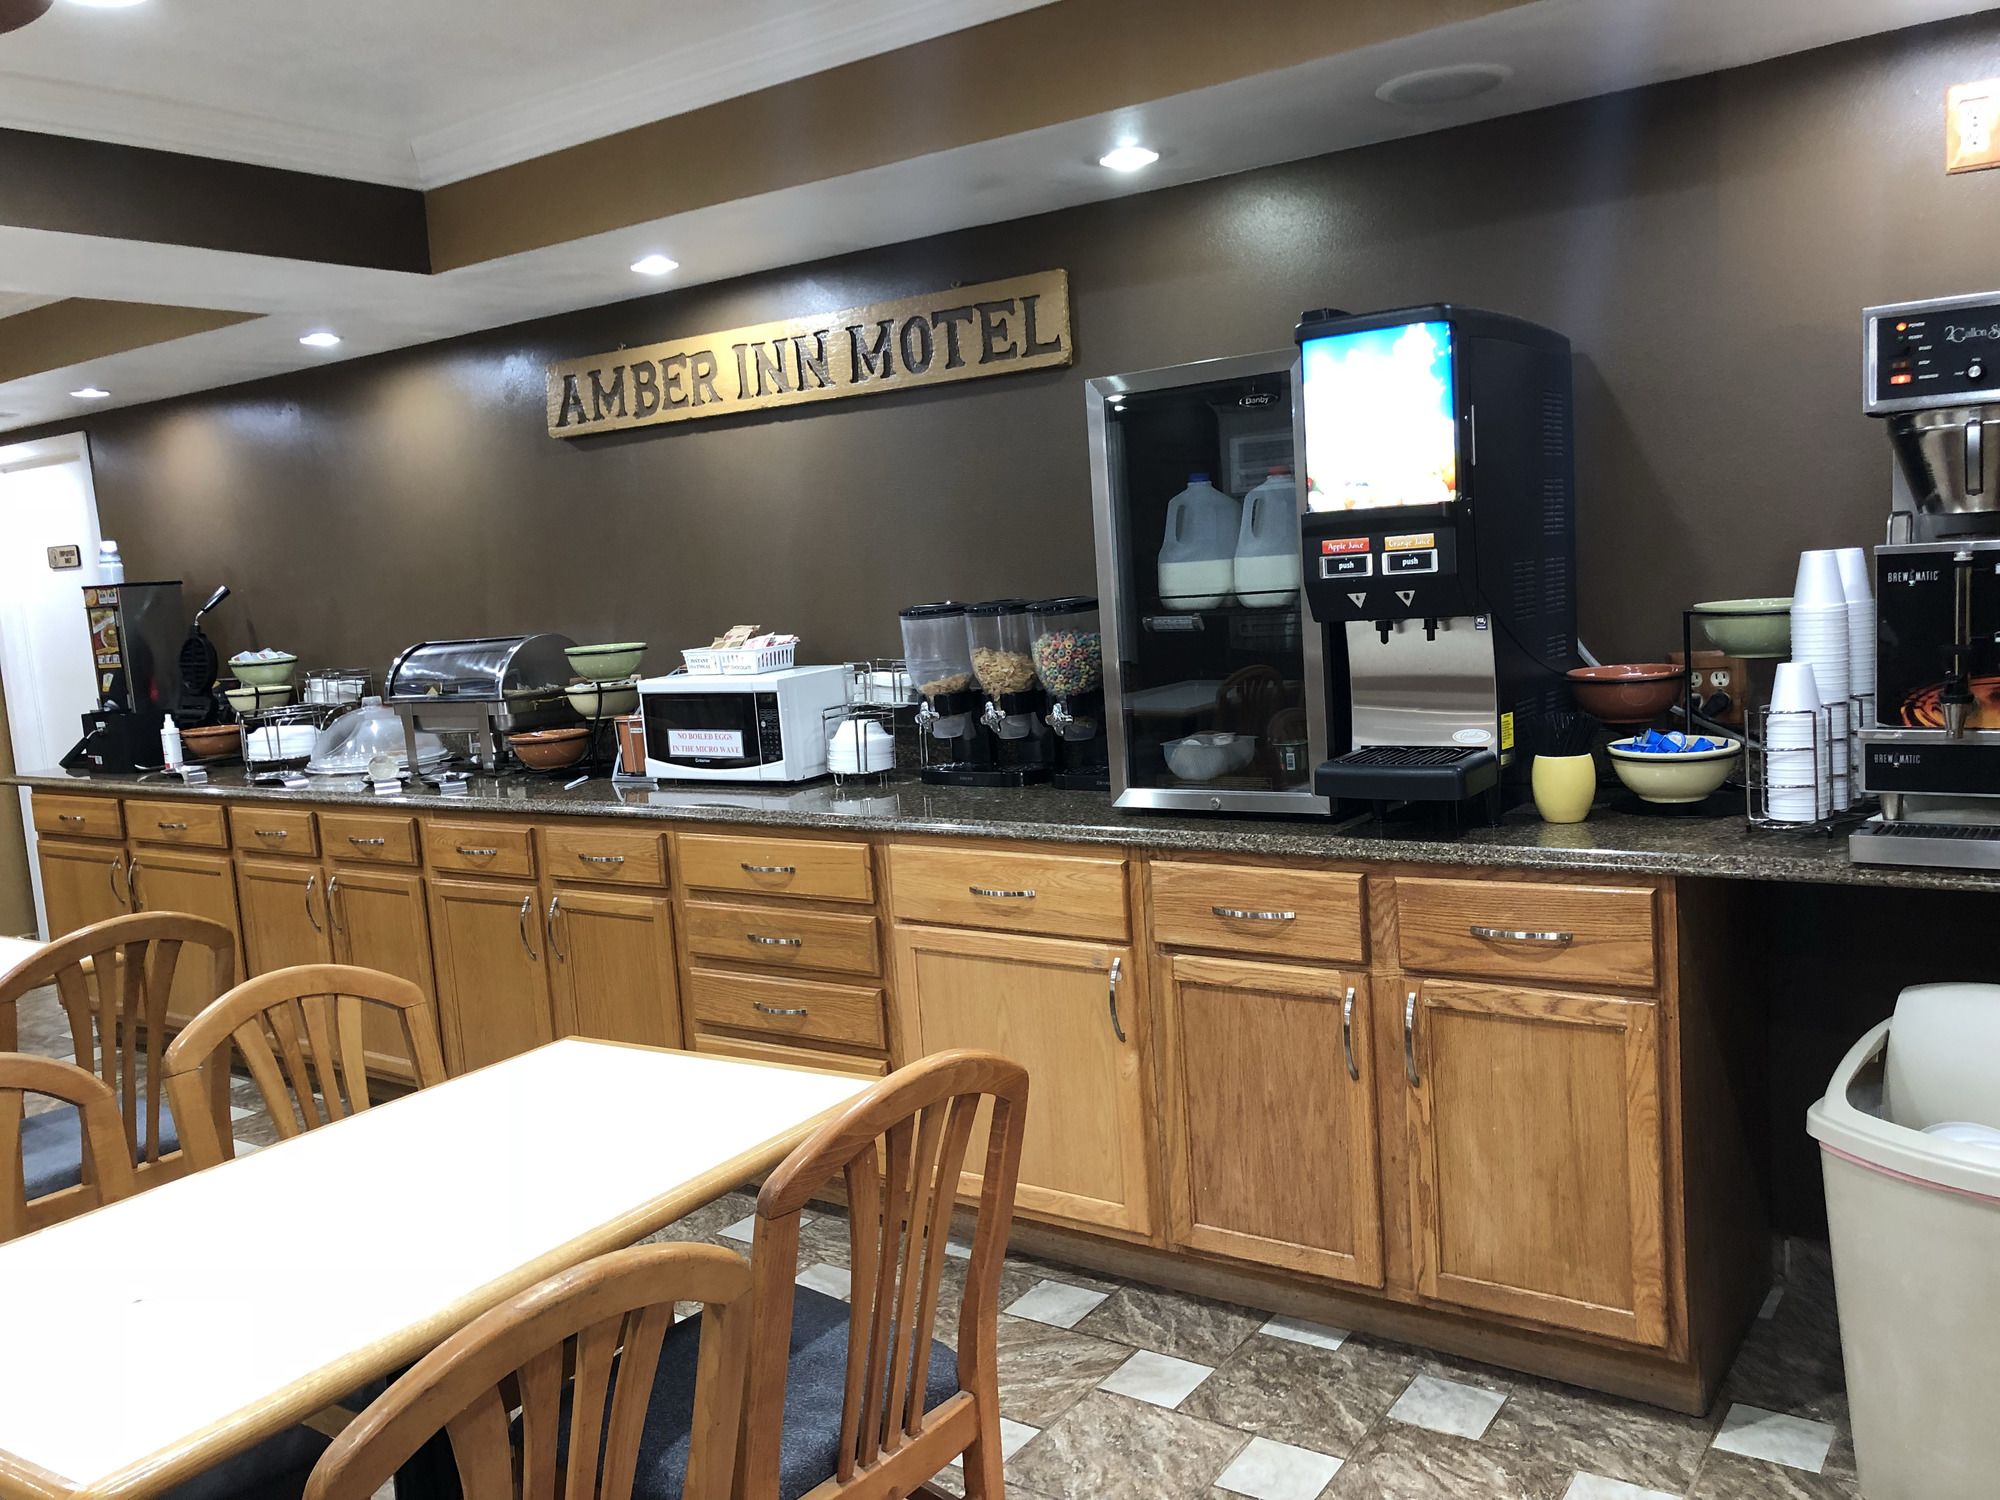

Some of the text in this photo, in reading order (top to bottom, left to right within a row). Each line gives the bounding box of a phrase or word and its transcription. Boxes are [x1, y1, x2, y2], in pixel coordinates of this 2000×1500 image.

[1952, 327, 1987, 343] Gallon
[555, 294, 1062, 428] AMBER INN MOTEL
[1245, 396, 1269, 405] Danby
[1328, 541, 1364, 552] Apple Juice
[1388, 537, 1431, 548] Orange Juice
[1339, 561, 1354, 571] push
[1402, 557, 1418, 567] push
[677, 732, 733, 741] NO BOILED EGGS
[672, 744, 741, 754] IN THE MICRO WAVE
